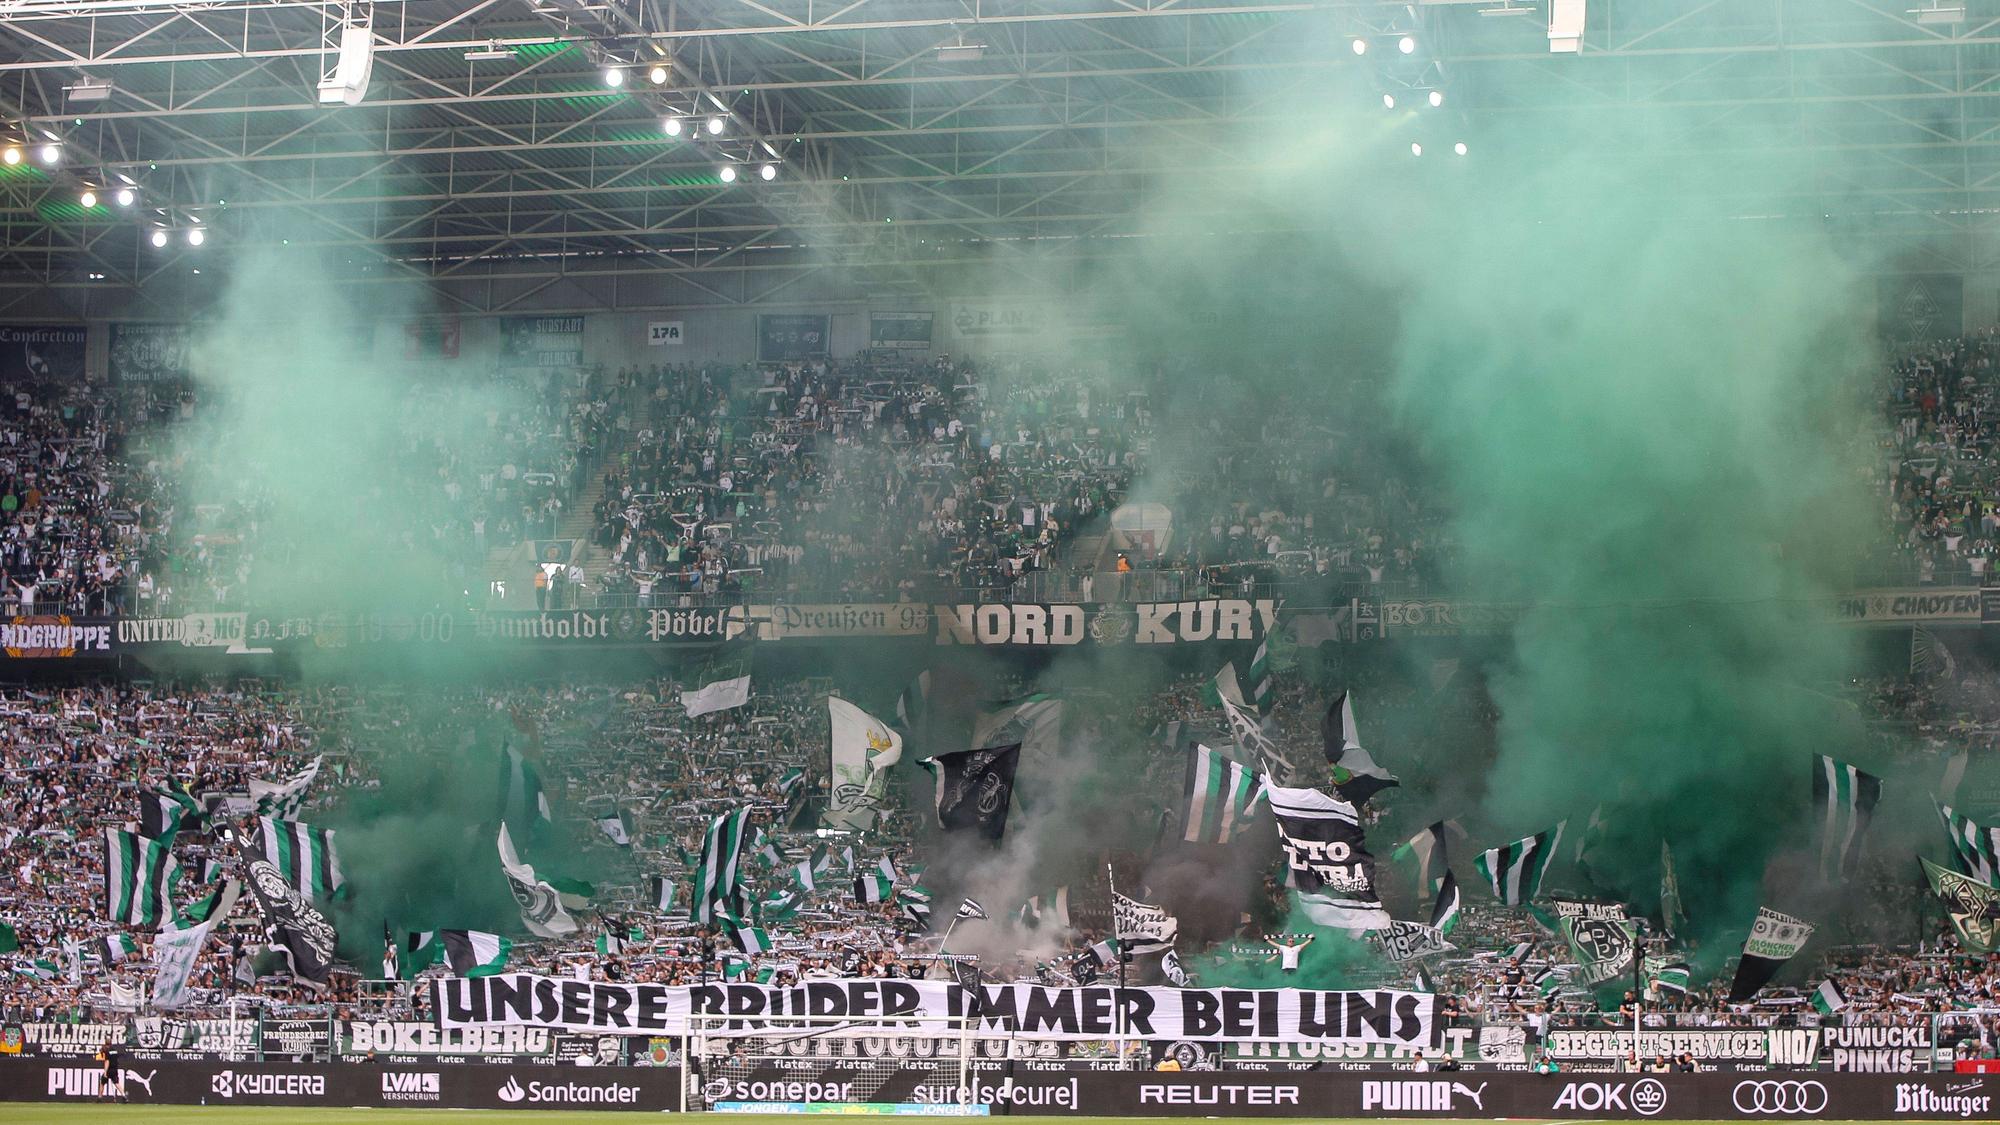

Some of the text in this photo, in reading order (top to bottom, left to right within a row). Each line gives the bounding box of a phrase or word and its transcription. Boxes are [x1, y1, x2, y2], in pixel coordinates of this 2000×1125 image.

[652, 327, 679, 339] 17A
[1892, 595, 1979, 616] CHAOTEN
[119, 617, 186, 643] UNITED
[647, 608, 727, 641] Pöbel
[935, 603, 1084, 645] NORD
[445, 975, 669, 1029] UNSERE
[947, 985, 1156, 1035] IMMER
[1182, 990, 1279, 1037] BEI
[1298, 991, 1421, 1042] UNS
[22, 1023, 127, 1045] WILLICHER
[197, 1019, 256, 1037] VITUS
[263, 1030, 329, 1040] FREUNDESKREIS
[1553, 1031, 1764, 1059] BEGLEITSERVICE
[1824, 1027, 1931, 1048] PUMUCKL
[134, 1052, 161, 1061] flatex
[176, 1052, 203, 1061] flatex
[389, 1055, 417, 1064] flatex
[436, 1055, 465, 1064] flatex
[484, 1056, 513, 1064] flatex
[773, 1060, 812, 1069] flatex
[835, 1060, 875, 1070] flatex
[899, 1060, 938, 1070] flatex
[1833, 1048, 1914, 1073] PINKIS
[1025, 1061, 1065, 1071] flatex
[1338, 1063, 1371, 1071] flatex
[1496, 1063, 1528, 1072] flatex
[1735, 1064, 1767, 1072] flatex
[236, 1074, 325, 1095] KYOCERA
[528, 1082, 641, 1103] Santander
[736, 1080, 852, 1104] sonepar
[382, 1092, 441, 1101] VERSICHERUNG
[1140, 1085, 1300, 1104] REUTER
[1362, 1080, 1451, 1111] PUMA
[1551, 1083, 1628, 1111] AOK
[1894, 1083, 1991, 1117] Bitburger
